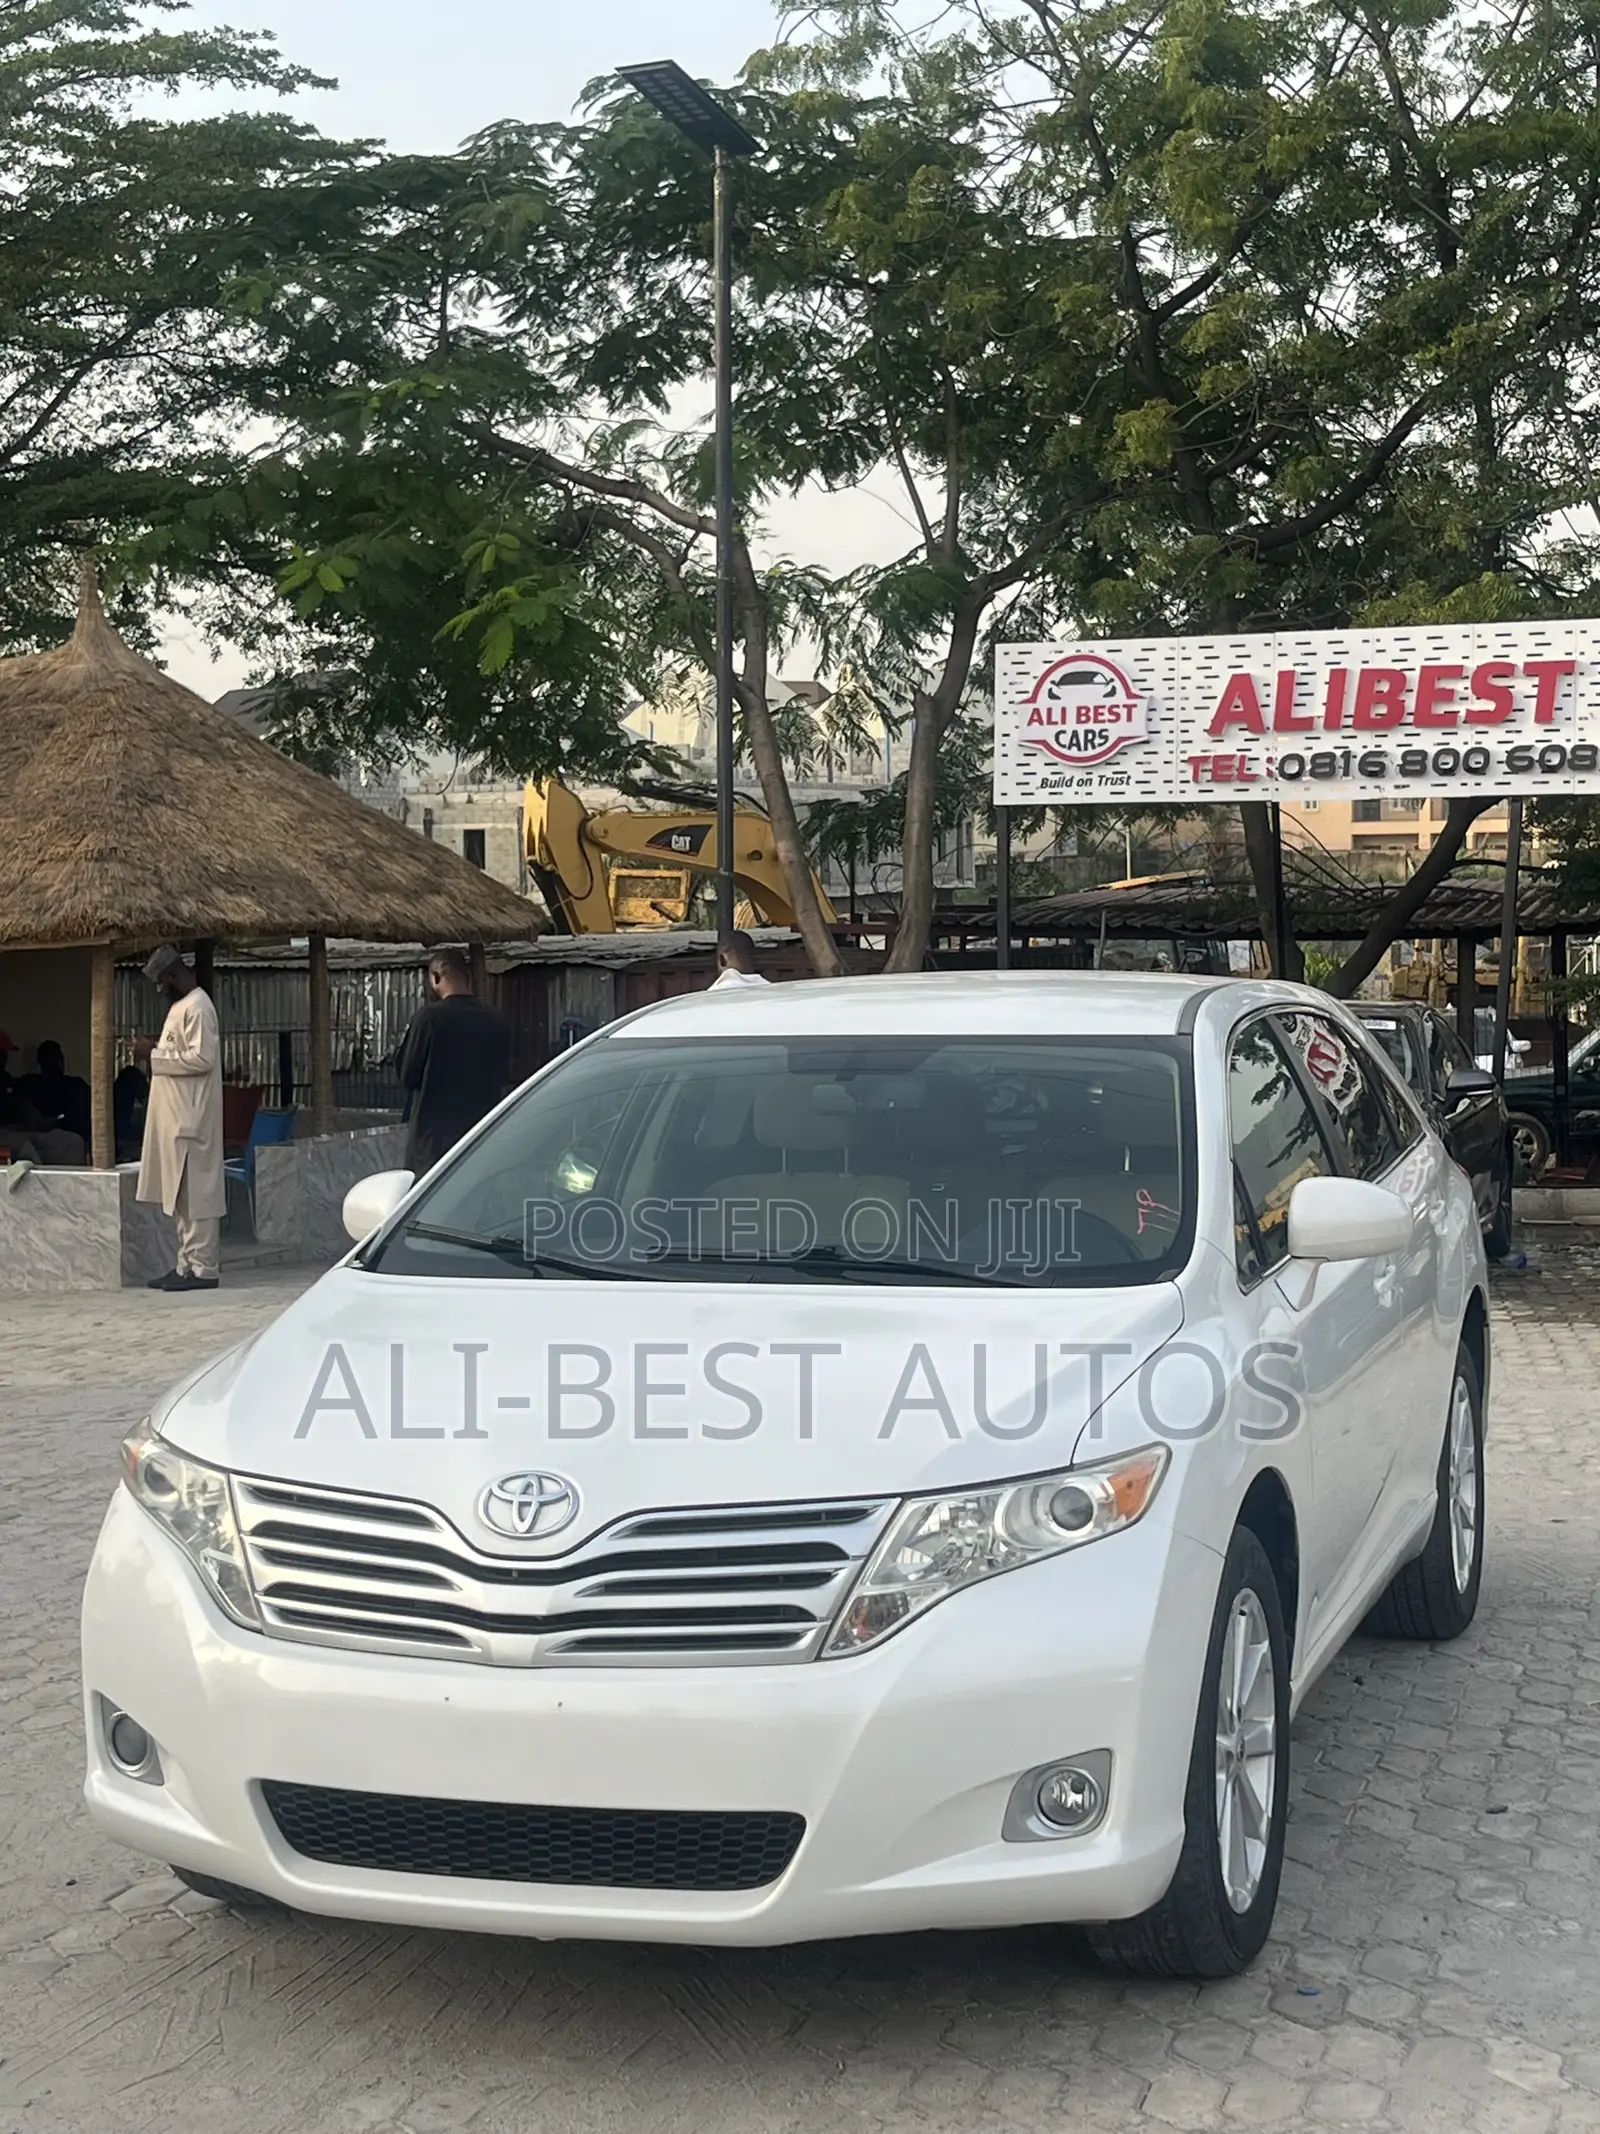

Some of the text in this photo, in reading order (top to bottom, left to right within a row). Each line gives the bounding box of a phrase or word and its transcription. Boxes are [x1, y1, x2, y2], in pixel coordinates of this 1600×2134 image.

[1207, 660, 1576, 737] ALIBEST
[1026, 703, 1138, 727] ALI BEST
[1054, 728, 1109, 752] CARS
[1400, 747, 1491, 778] 800
[1040, 774, 1132, 790] Build on Trust
[671, 834, 691, 852] CAT
